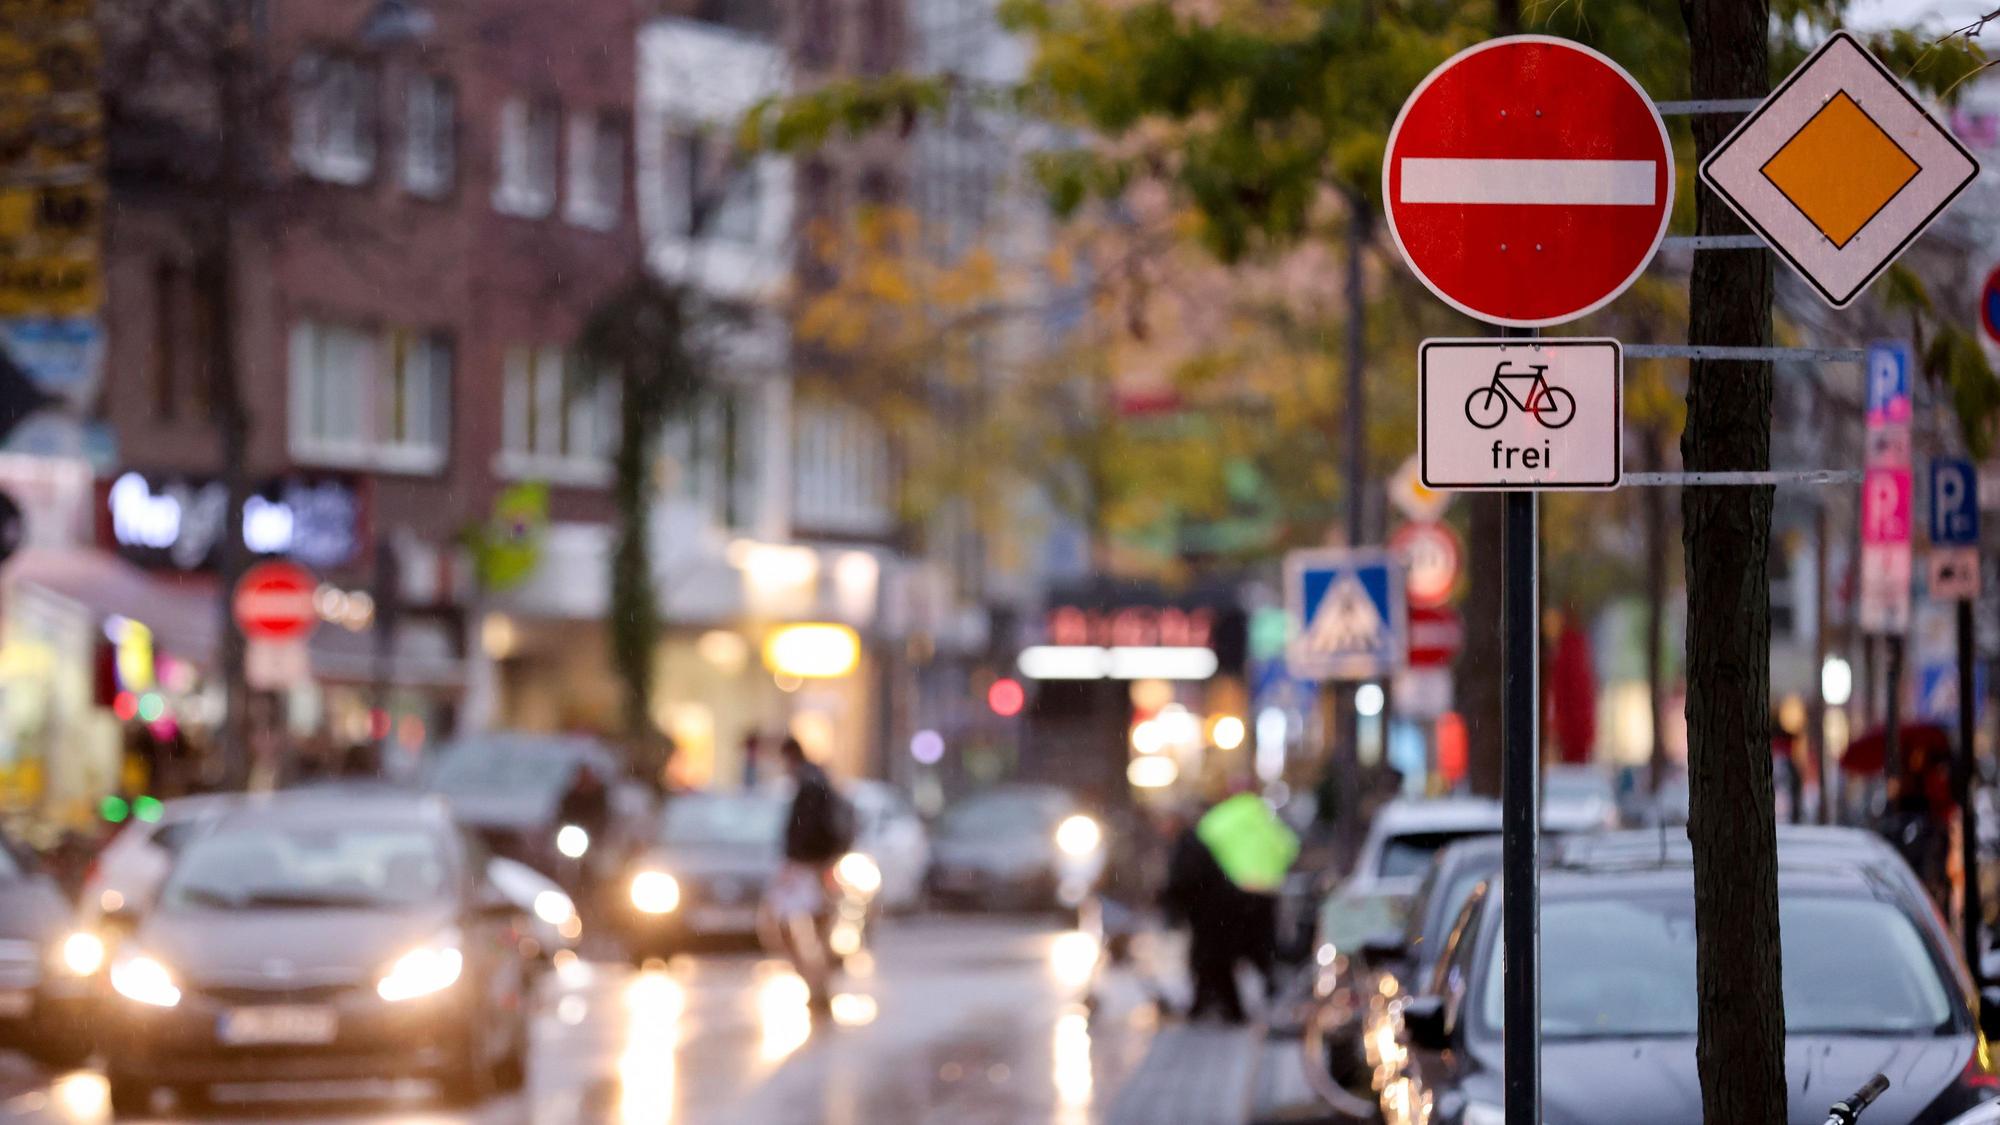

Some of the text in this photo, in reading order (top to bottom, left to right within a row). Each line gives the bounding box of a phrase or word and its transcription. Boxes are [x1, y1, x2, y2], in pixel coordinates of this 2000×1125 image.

[1870, 349, 1900, 413] P
[1491, 439, 1551, 470] frei
[1936, 467, 1966, 537] P
